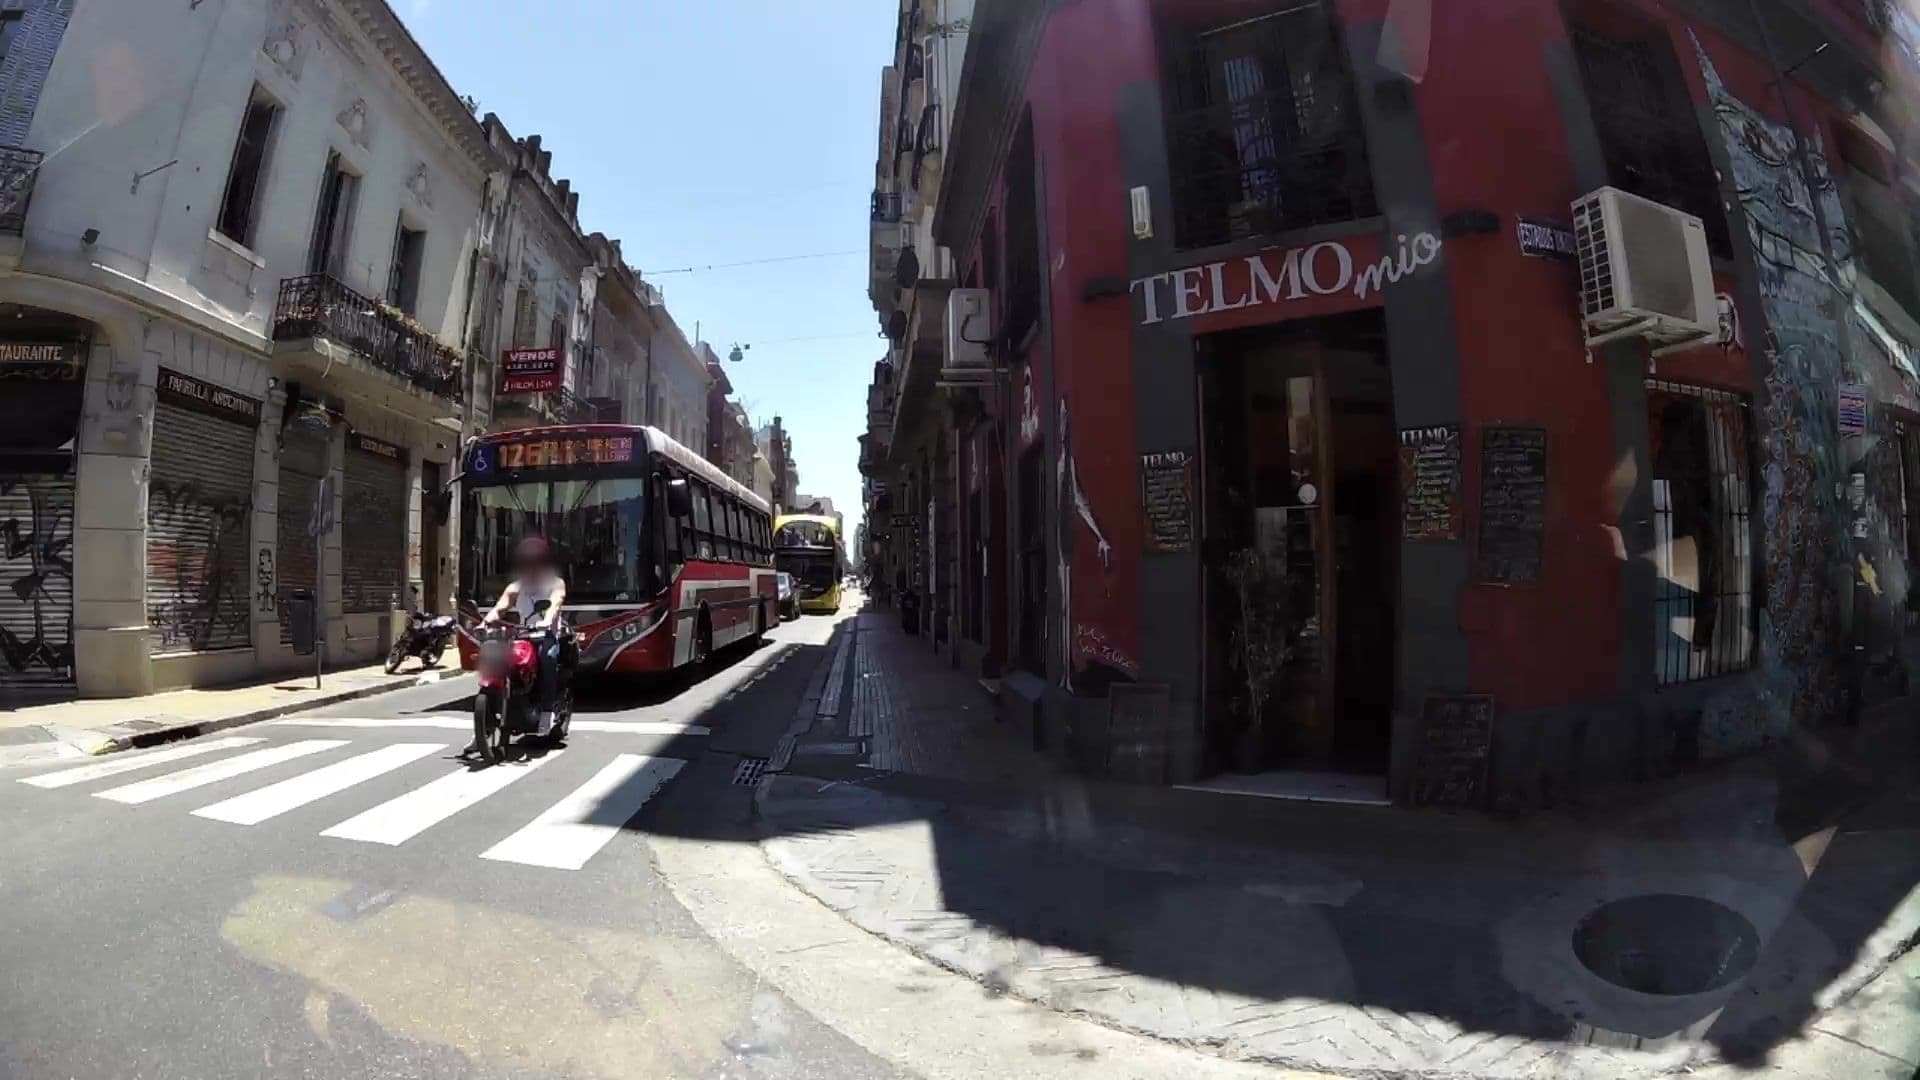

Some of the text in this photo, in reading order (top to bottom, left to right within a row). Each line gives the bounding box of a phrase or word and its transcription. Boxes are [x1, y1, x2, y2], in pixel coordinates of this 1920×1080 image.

[1129, 231, 1442, 324] TELMO mio
[510, 350, 557, 361] VENDE
